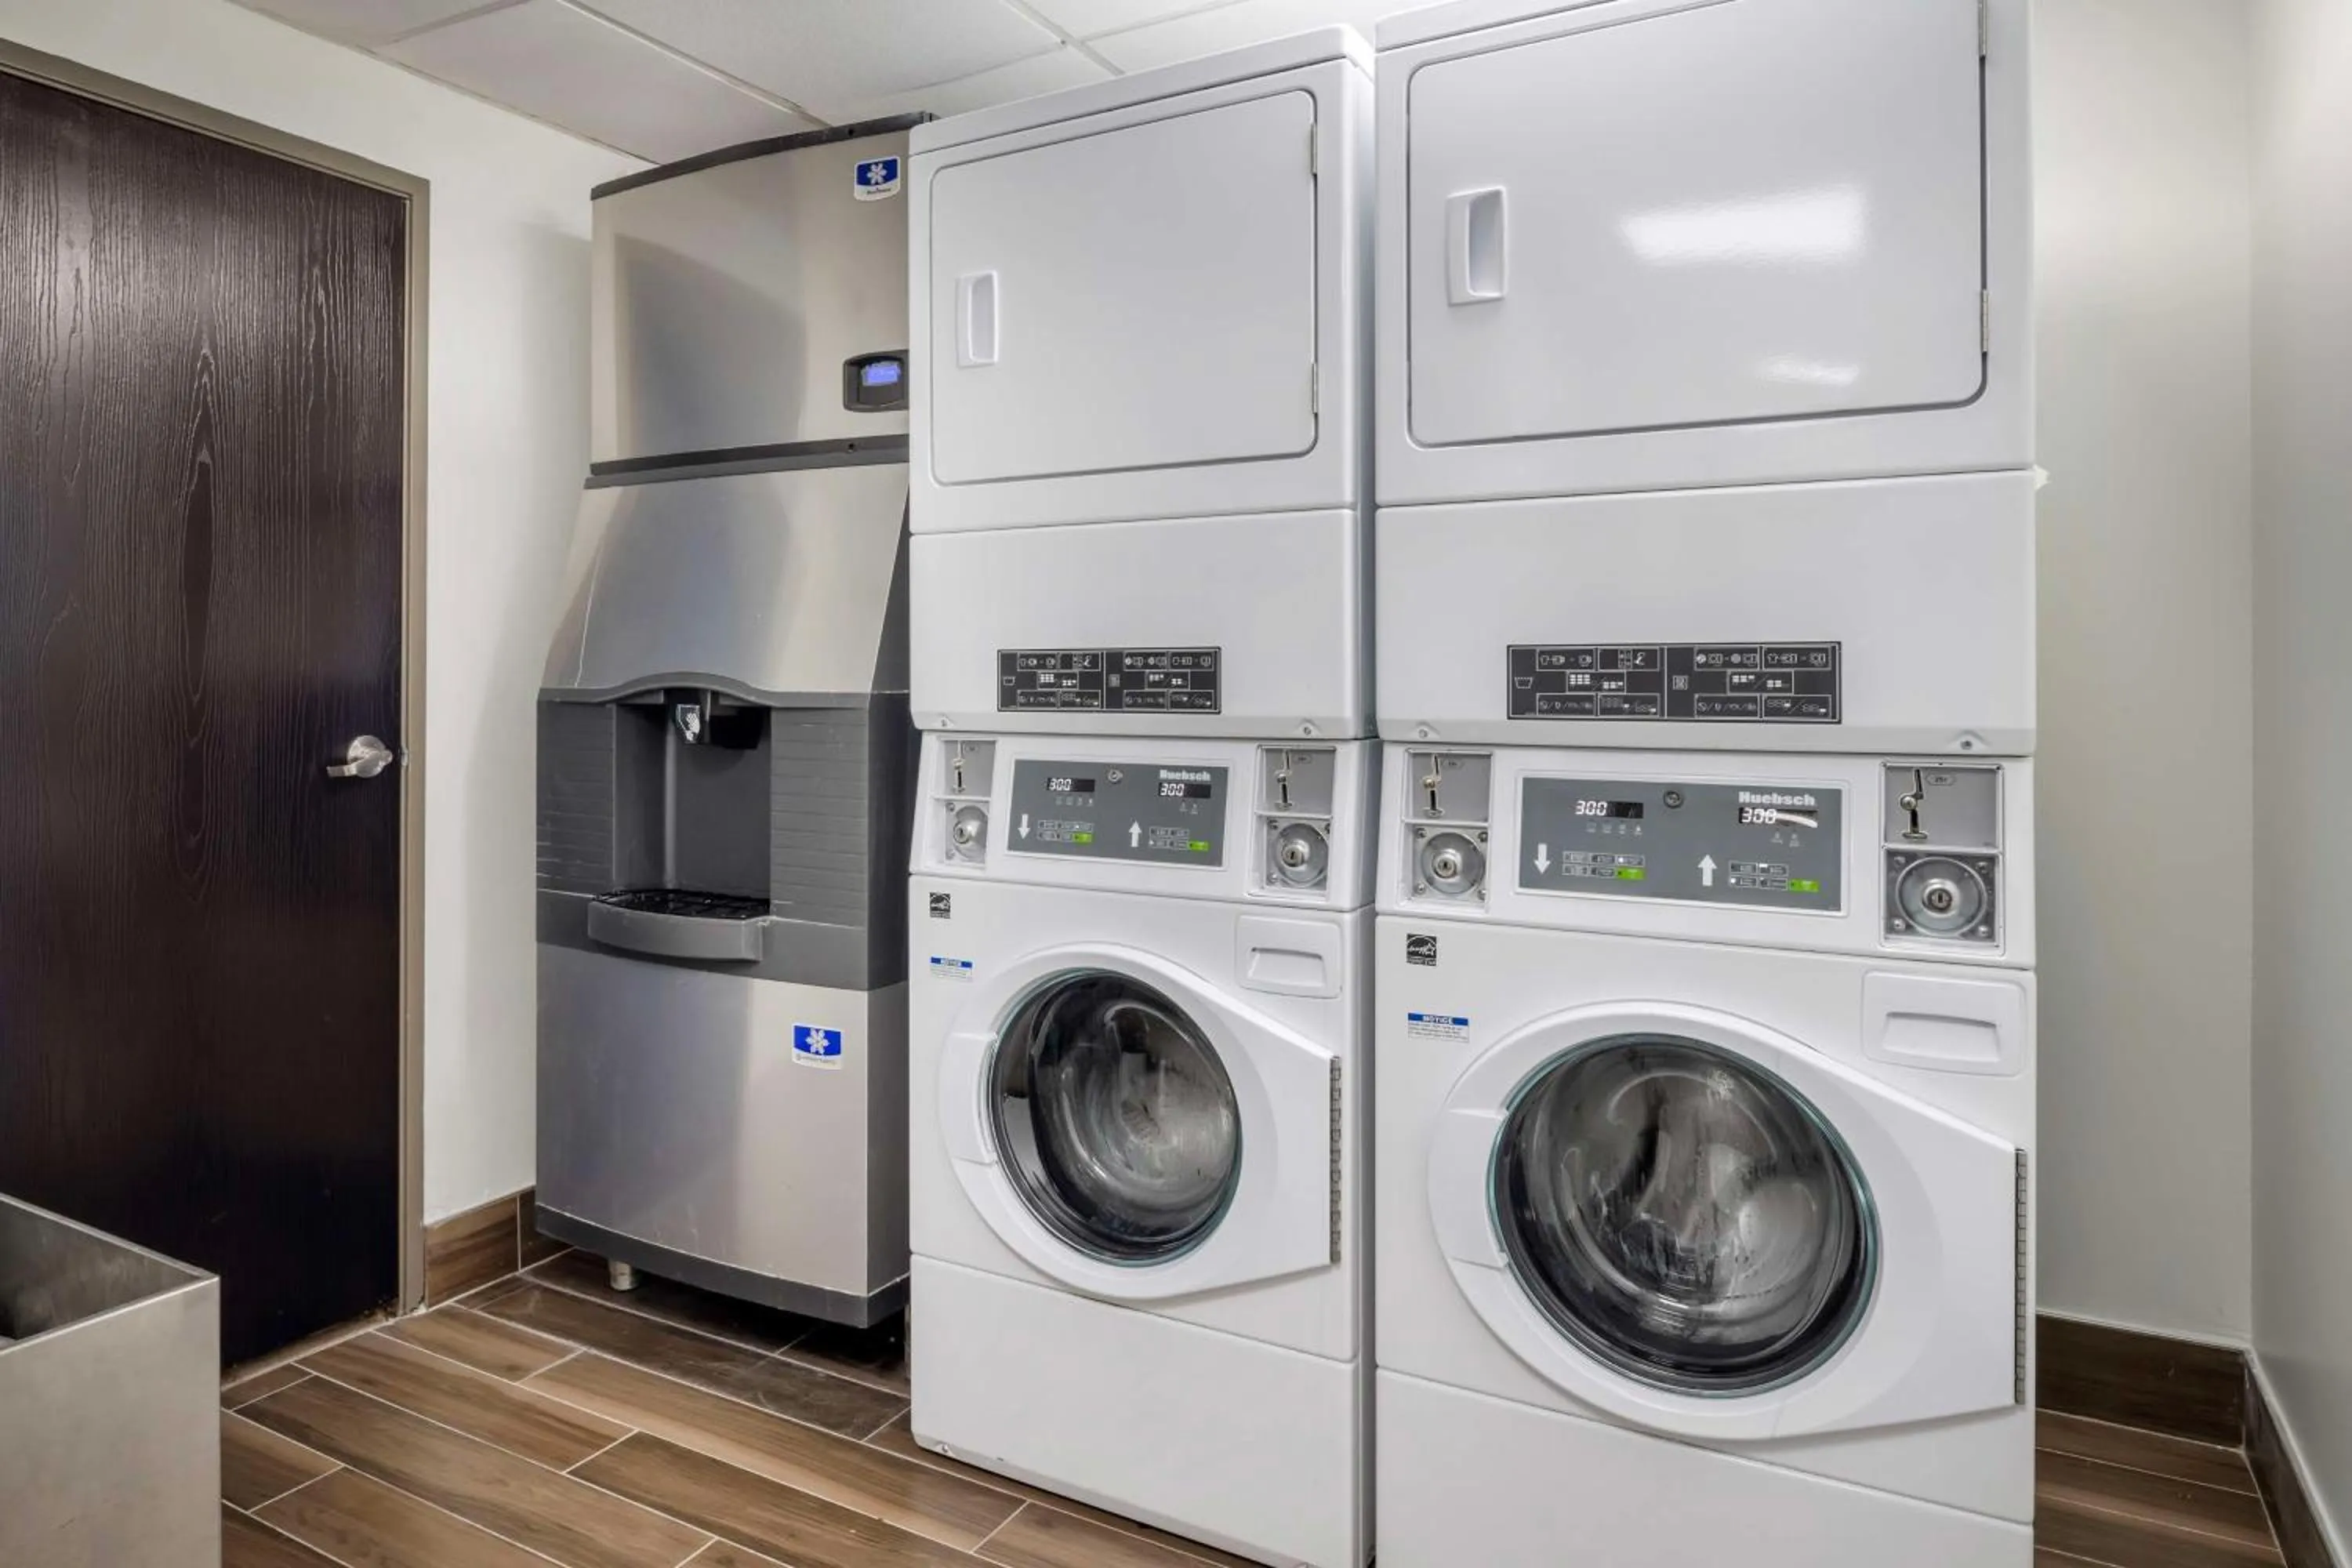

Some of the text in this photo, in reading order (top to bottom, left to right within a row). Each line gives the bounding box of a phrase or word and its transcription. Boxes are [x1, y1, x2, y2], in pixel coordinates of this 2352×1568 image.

[1050, 778, 1072, 791] 300
[1160, 783, 1185, 796] 300
[1738, 791, 1816, 806] Huebsch
[1575, 800, 1608, 816] 300
